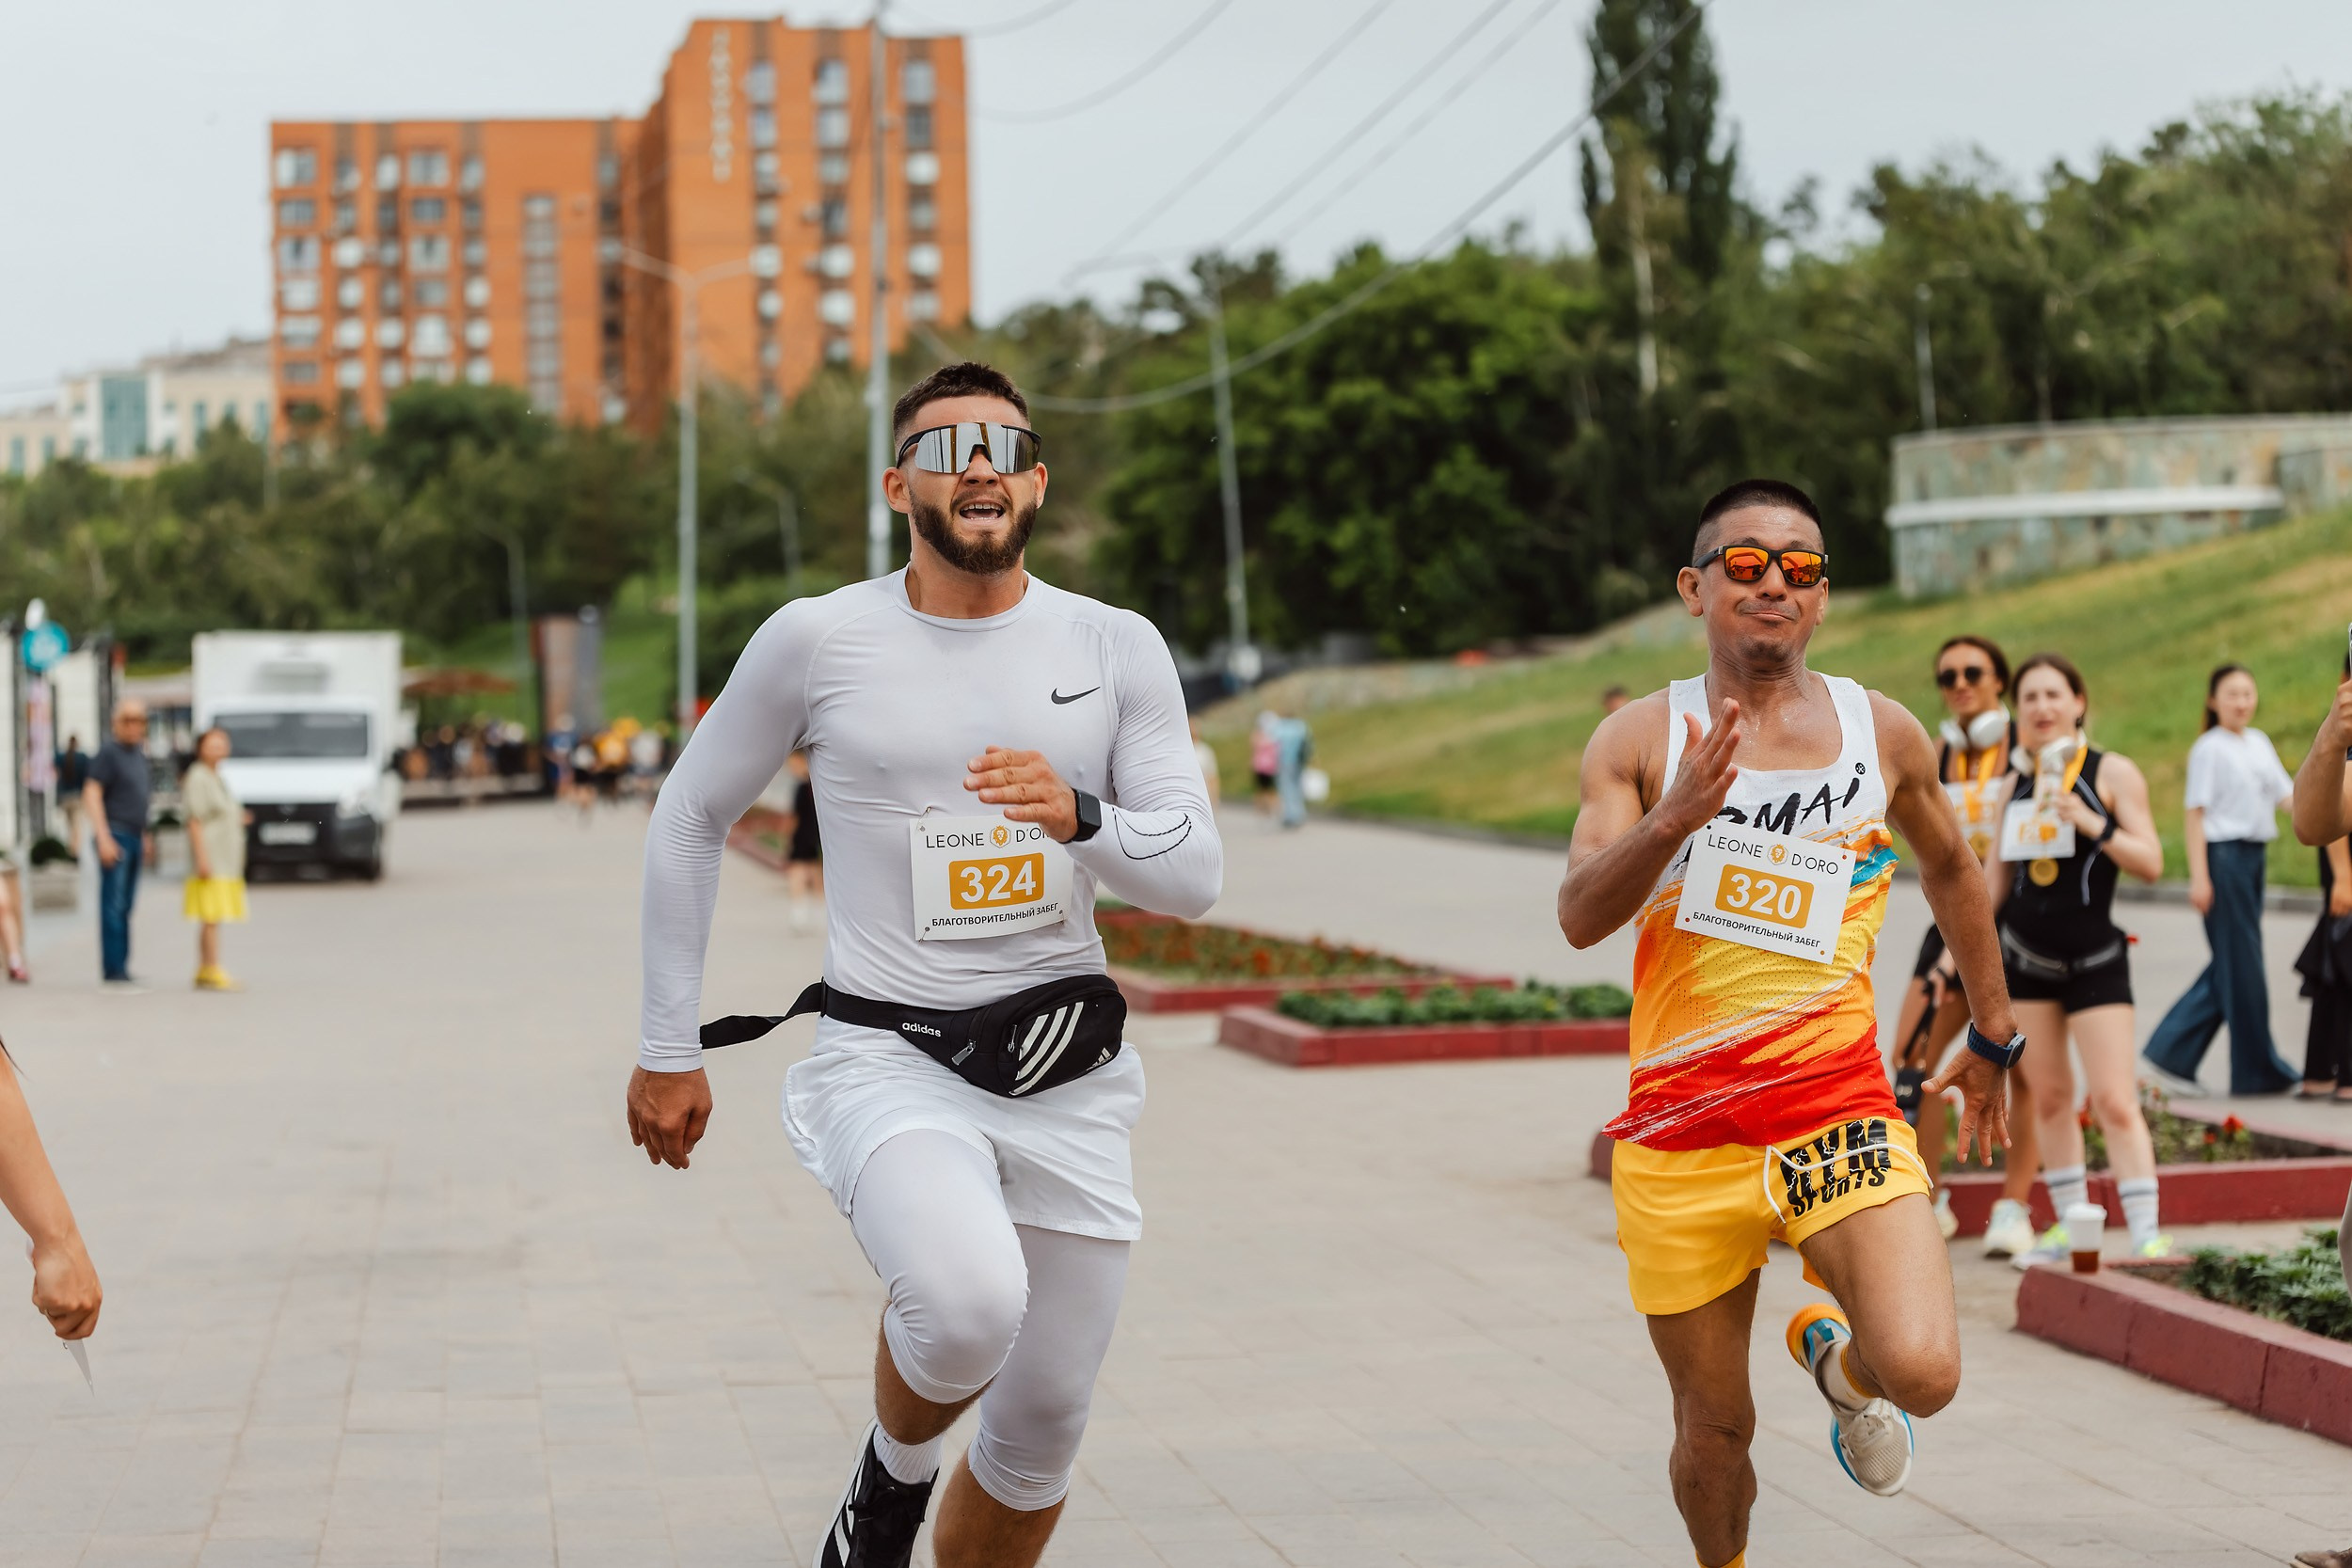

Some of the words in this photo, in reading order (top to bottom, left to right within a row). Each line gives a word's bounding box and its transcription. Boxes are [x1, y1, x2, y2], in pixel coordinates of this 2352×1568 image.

[926, 832, 985, 848] LEONE
[1708, 833, 1763, 859] LEONE
[1791, 852, 1838, 875] D'ORO
[960, 860, 1037, 904] 324
[1725, 873, 1802, 920] 320
[931, 907, 1035, 927] БЛАГОТВОРИТЕЛЬНЫЙ
[1036, 902, 1059, 915] ЗАБЕГ
[1692, 911, 1793, 942] БЛАГОТВОРИТЕЛЬНЫЙ
[1794, 935, 1821, 948] ЗАБЕГ
[901, 1022, 942, 1038] adidas
[1779, 1118, 1892, 1196] GYM
